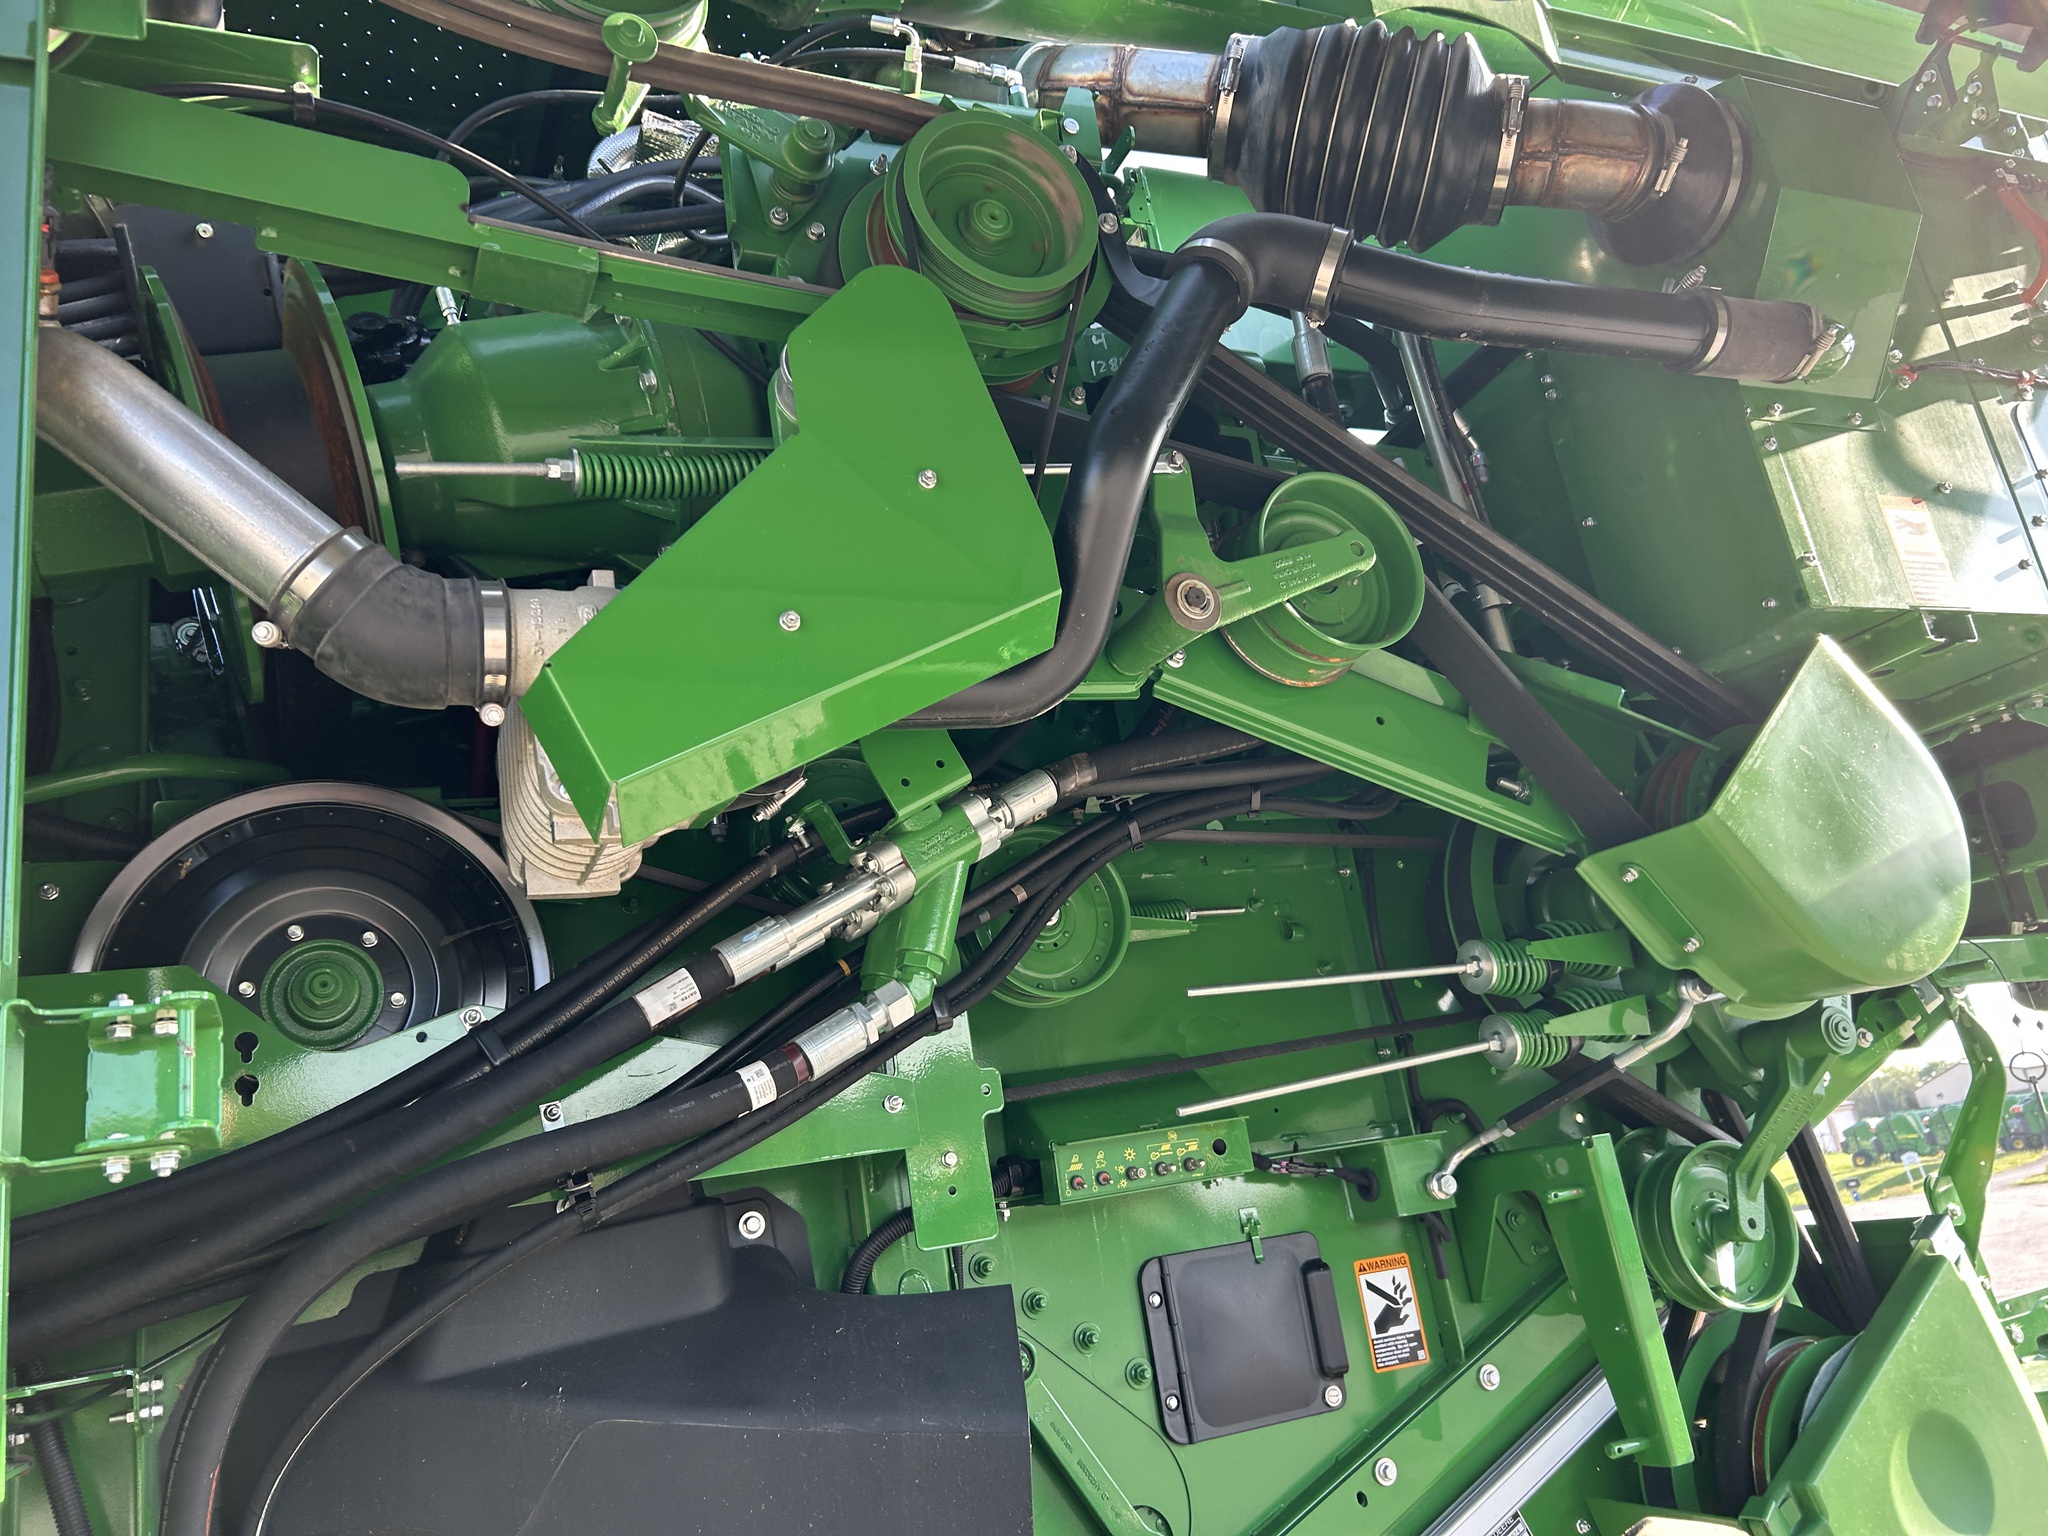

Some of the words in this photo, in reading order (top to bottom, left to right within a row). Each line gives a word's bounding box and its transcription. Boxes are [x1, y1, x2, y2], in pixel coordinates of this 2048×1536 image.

[1091, 332, 1108, 350] 4
[692, 907, 707, 921] Flame
[706, 891, 729, 911] Resistant
[1366, 1256, 1406, 1271] WARNING
